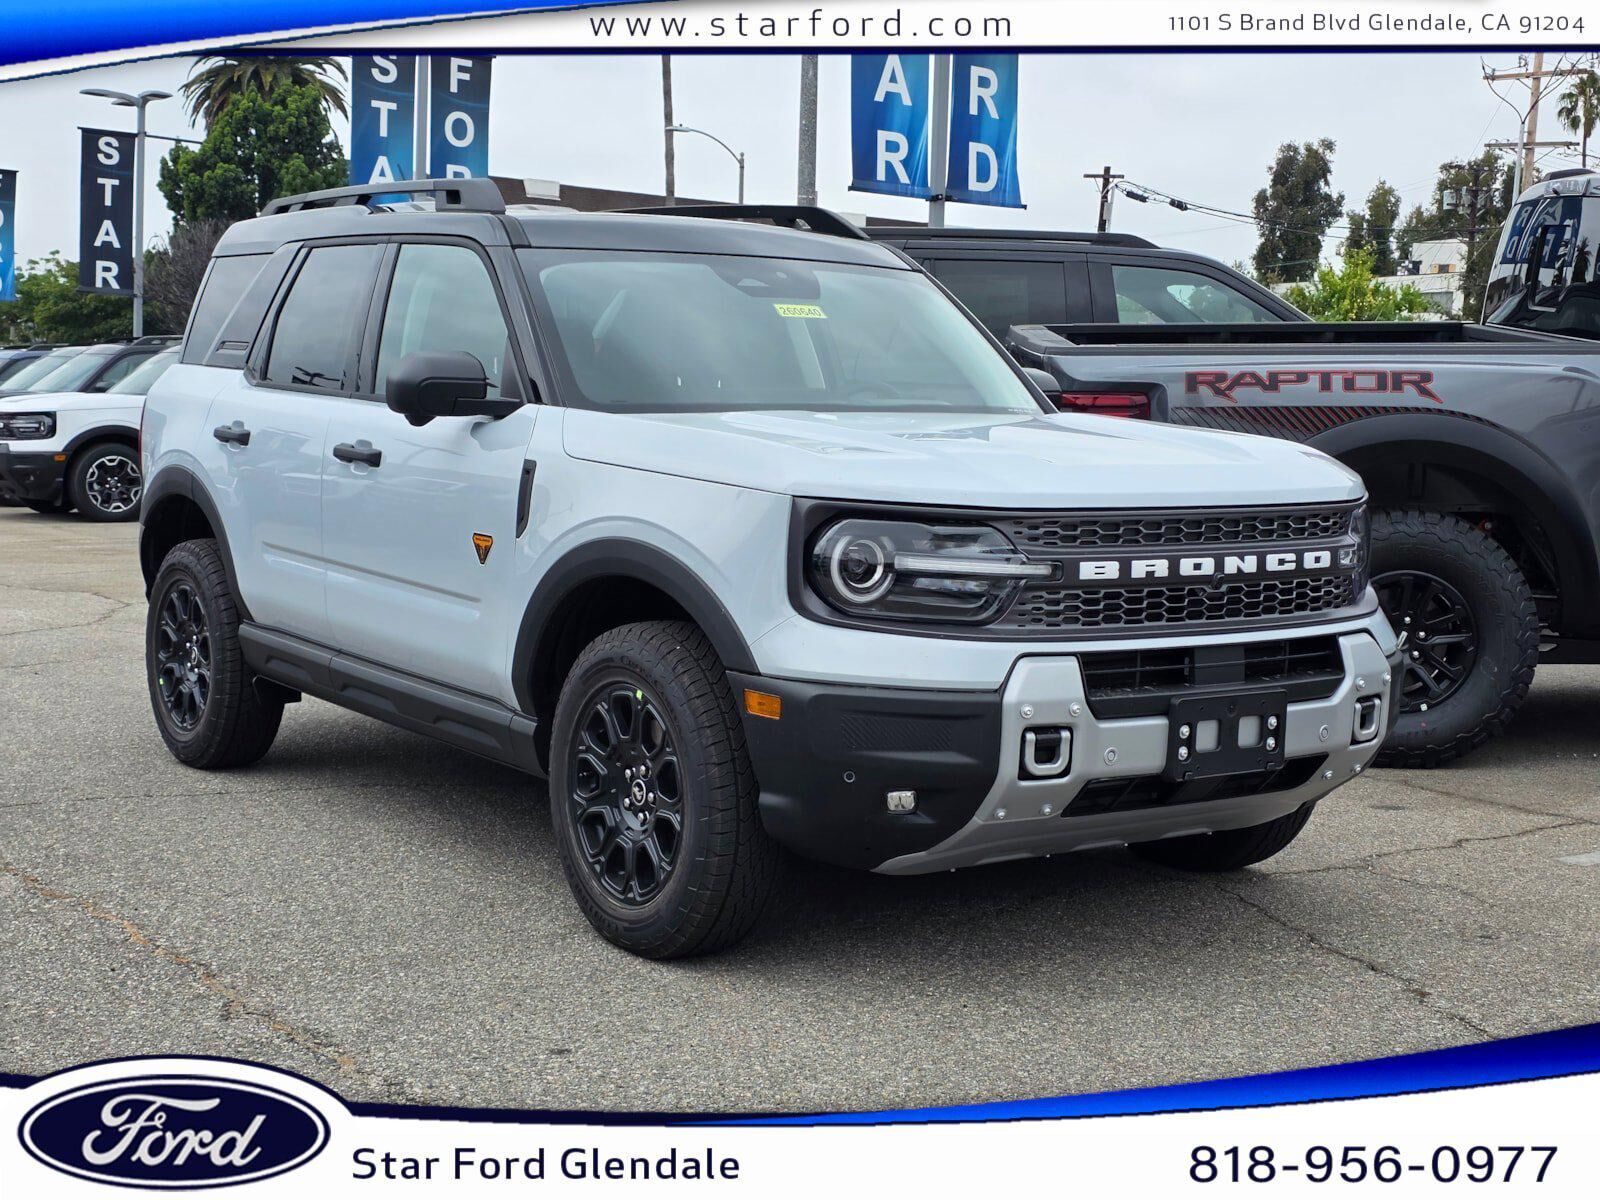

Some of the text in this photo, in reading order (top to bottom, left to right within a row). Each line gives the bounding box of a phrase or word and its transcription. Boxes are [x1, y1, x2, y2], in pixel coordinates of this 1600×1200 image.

[968, 65, 1000, 192] RD
[93, 136, 121, 290] STAR
[1184, 370, 1444, 404] RAPTOR
[1079, 550, 1331, 580] BRONCO
